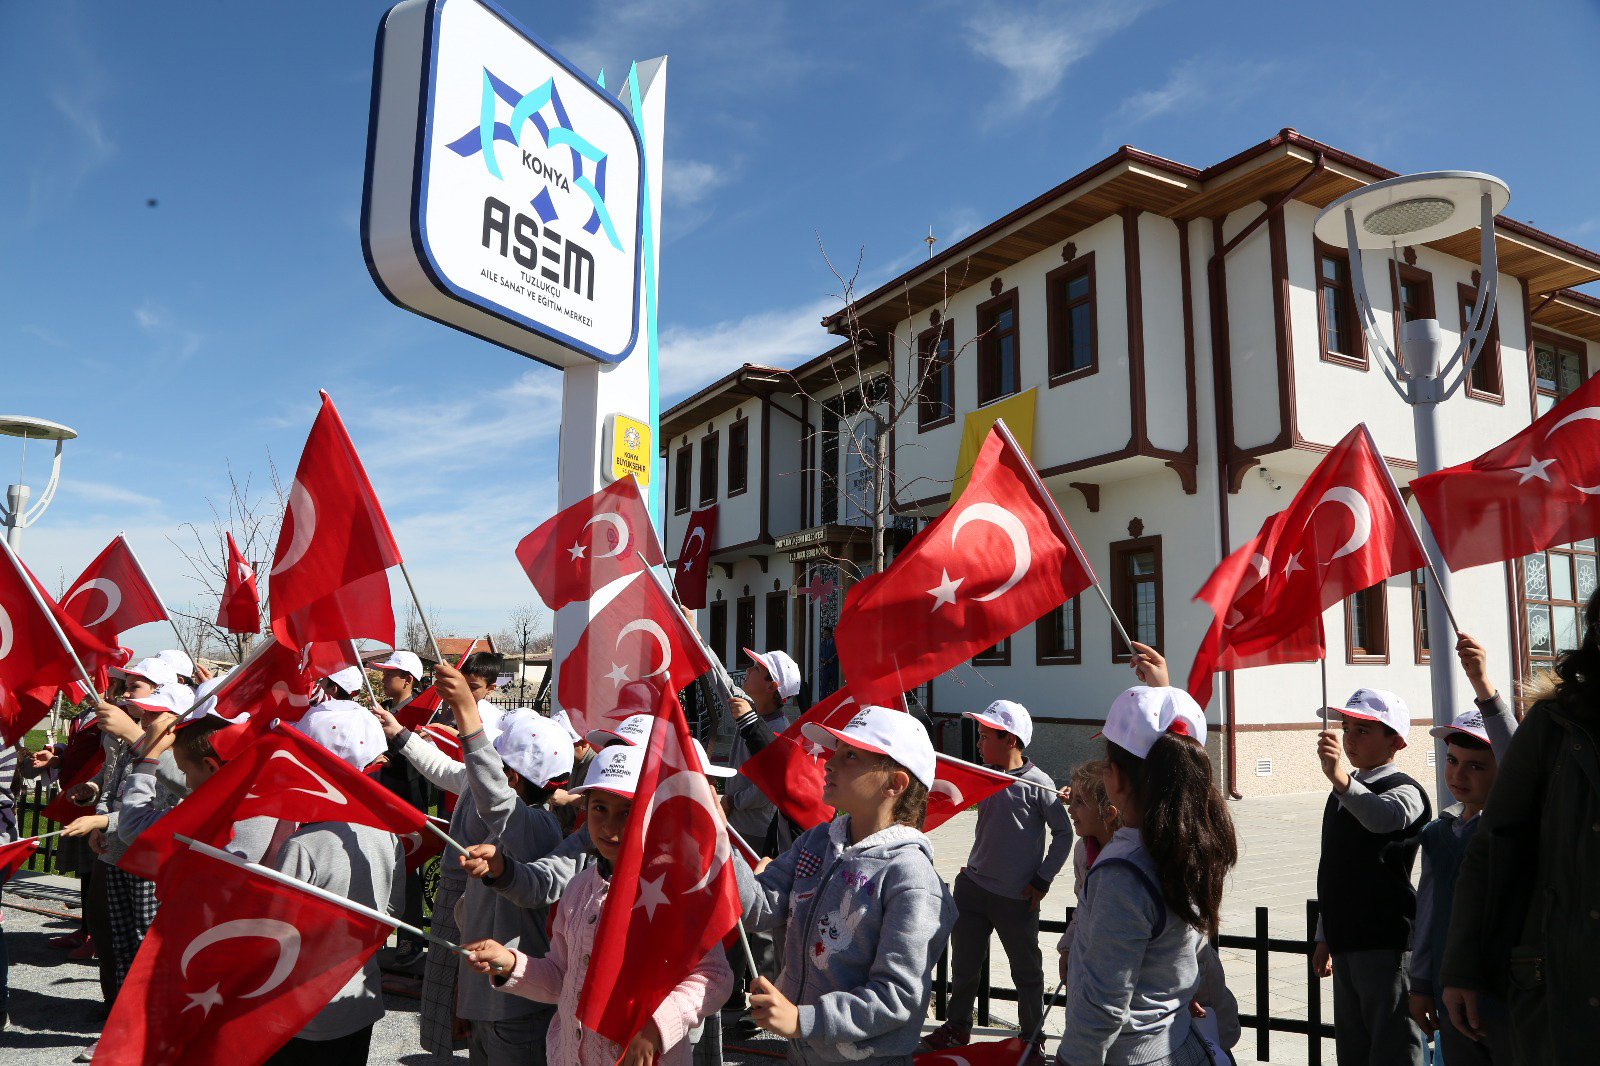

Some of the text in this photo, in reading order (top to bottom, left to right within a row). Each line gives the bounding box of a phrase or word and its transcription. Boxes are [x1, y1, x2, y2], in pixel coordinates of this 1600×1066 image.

[522, 149, 570, 194] KONYA
[481, 196, 595, 301] ASEM
[480, 267, 593, 328] AİLE SANAT VE EĞİTİM MERKEZİ
[520, 271, 561, 298] TUZLUKÇU
